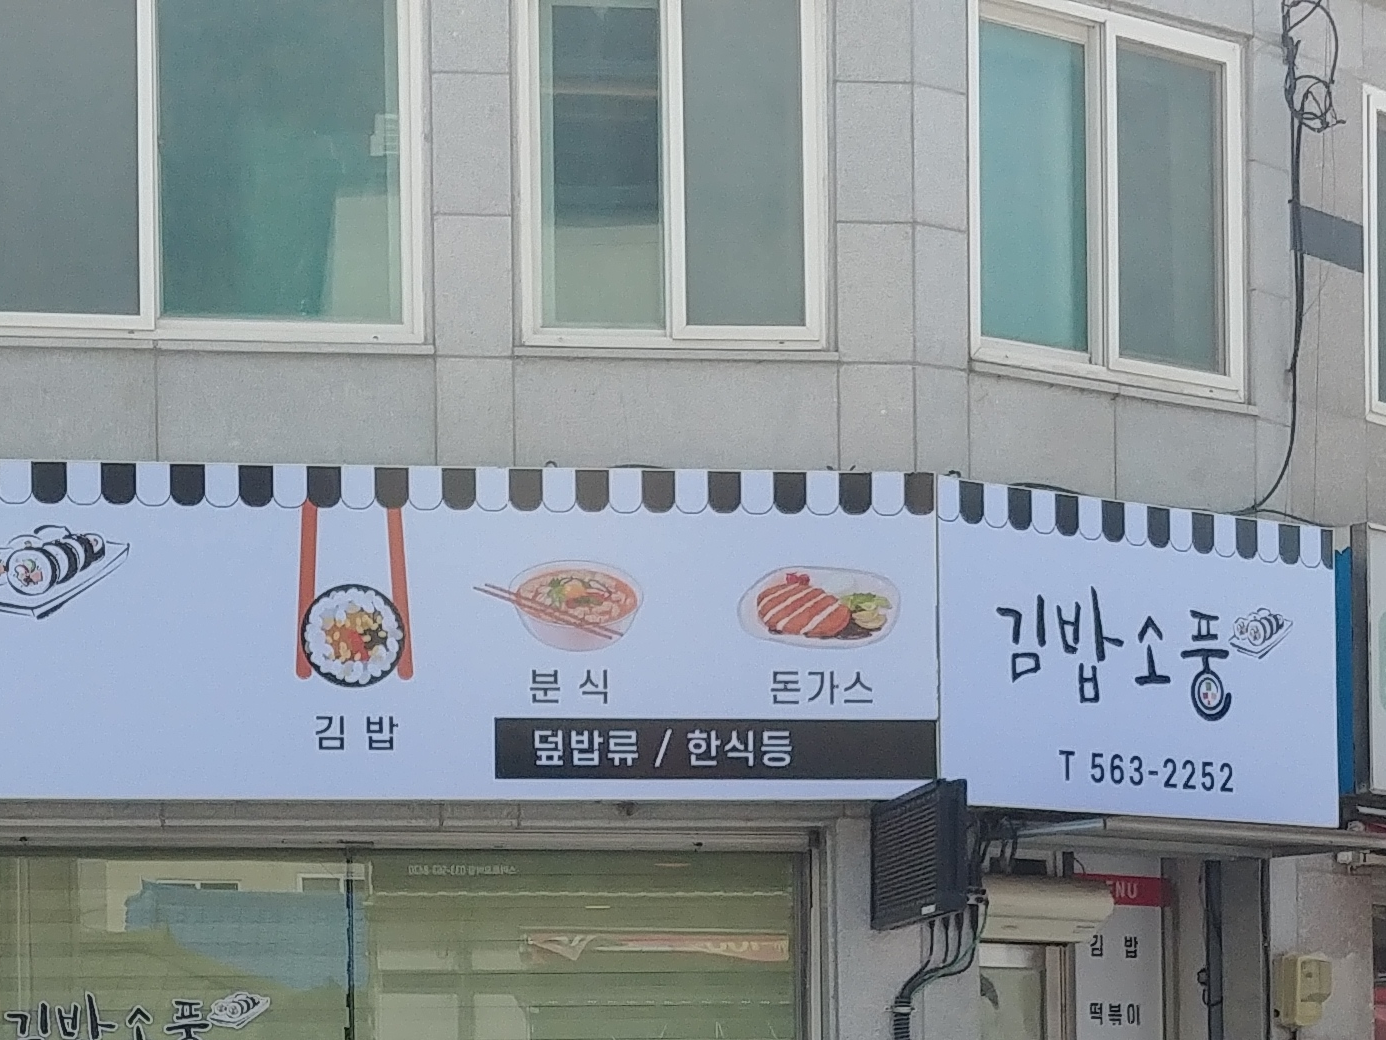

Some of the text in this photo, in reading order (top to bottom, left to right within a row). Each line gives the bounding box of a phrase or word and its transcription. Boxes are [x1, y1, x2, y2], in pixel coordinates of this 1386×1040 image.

[996, 586, 1232, 721] 김밥소풍
[769, 670, 874, 705] 돈가스
[533, 729, 640, 768] 덮밥류
[687, 729, 794, 768] 한식등
[1059, 750, 1235, 792] T 563-2252
[1089, 1002, 1141, 1025] 떡볶이
